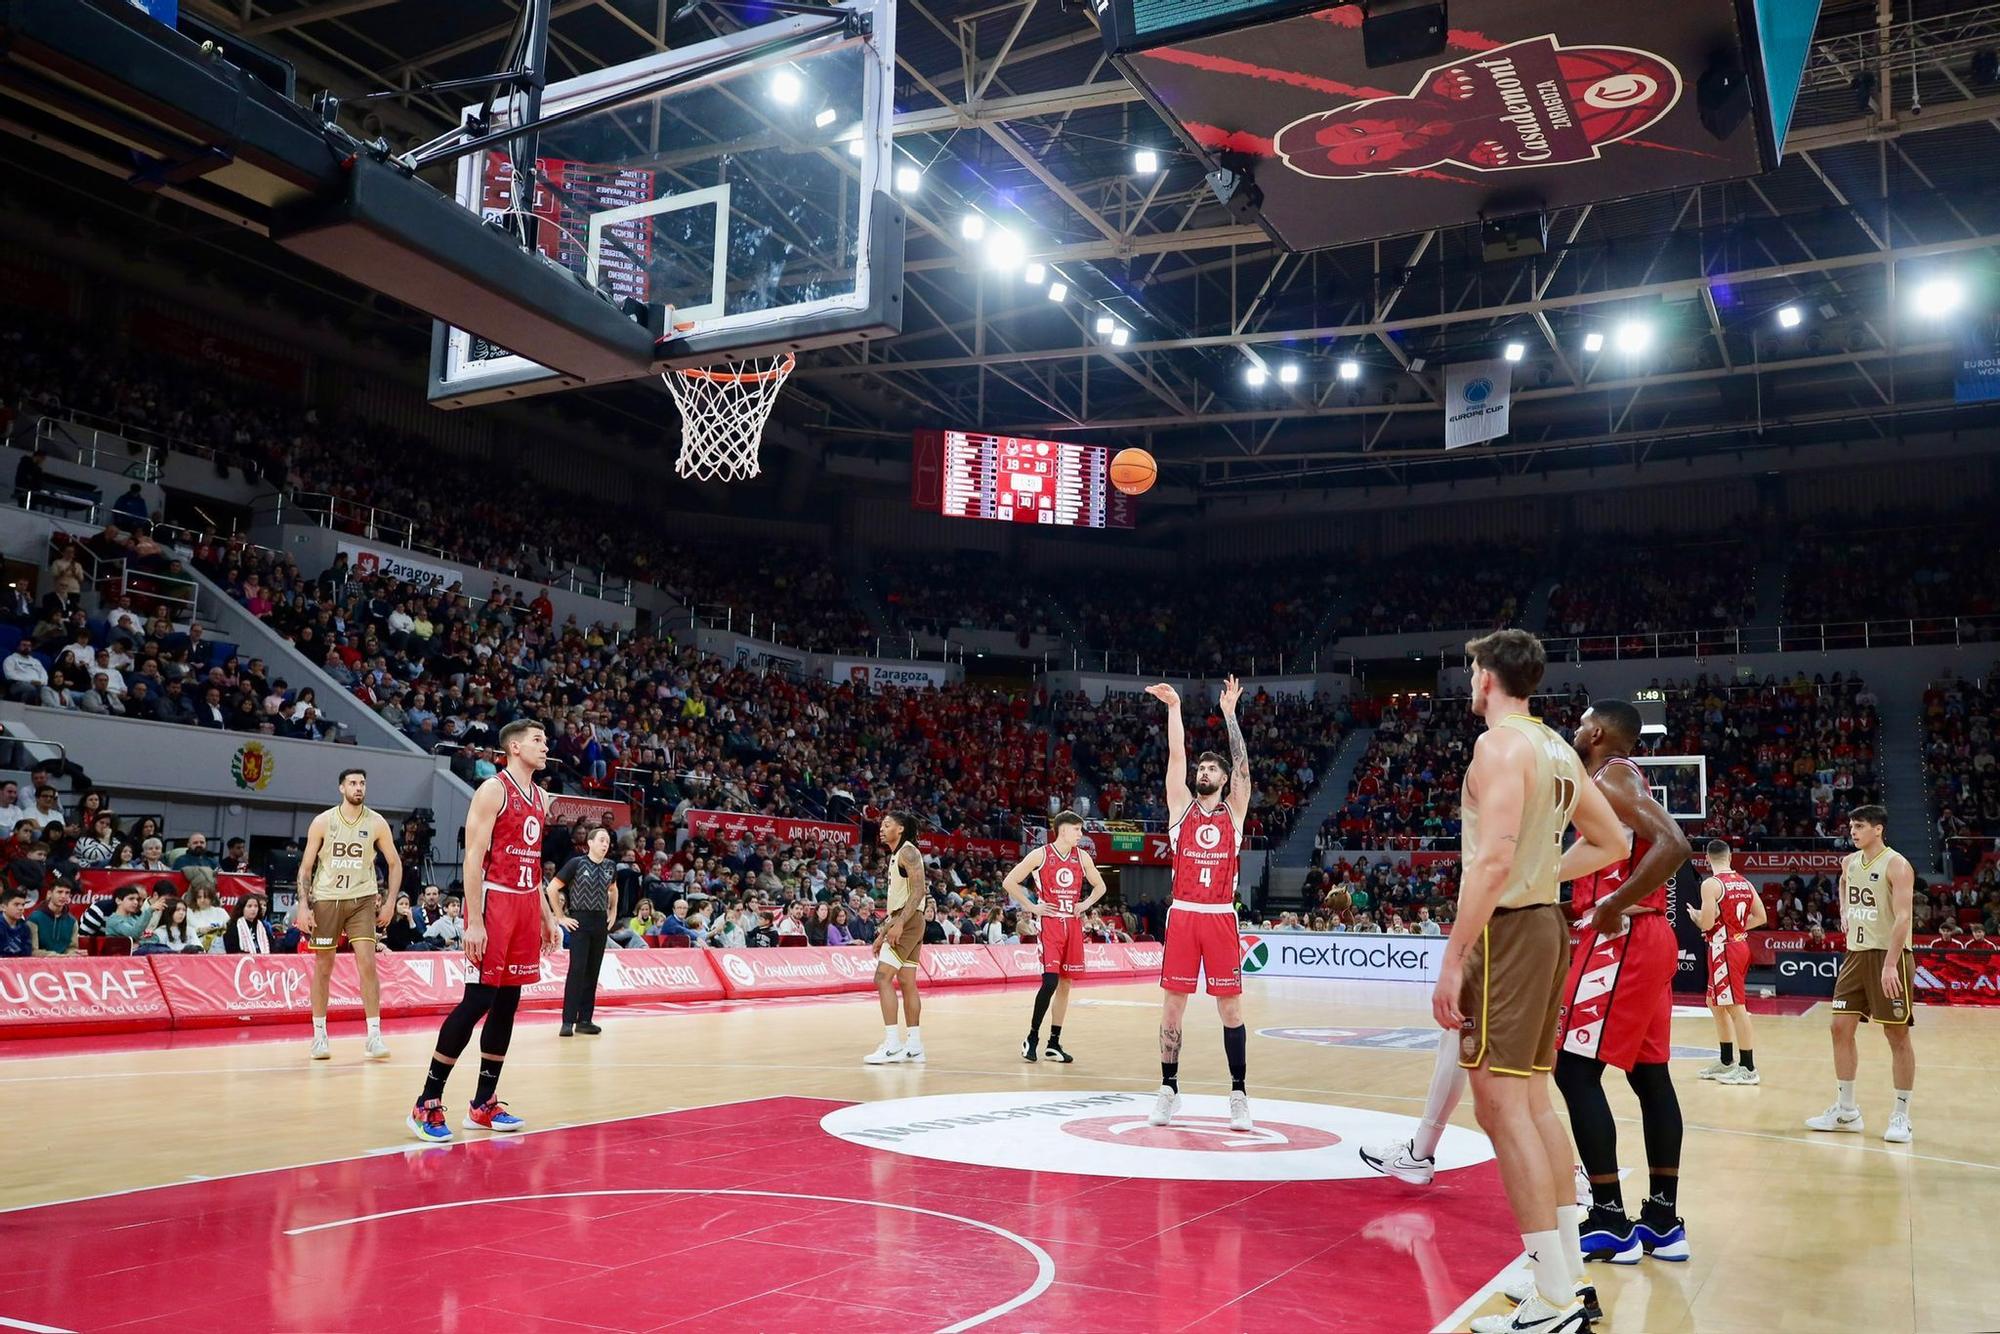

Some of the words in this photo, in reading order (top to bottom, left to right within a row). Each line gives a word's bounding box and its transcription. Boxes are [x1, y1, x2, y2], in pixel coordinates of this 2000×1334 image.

[1474, 57, 1552, 161] Casademont
[1536, 79, 1572, 130] ZARAGOZA
[1449, 409, 1484, 423] EUROPE
[1485, 405, 1504, 415] CUP
[874, 667, 929, 683] Zaragoza
[1636, 690, 1659, 701] 1:49
[788, 826, 803, 839] AIR
[332, 842, 363, 858] BG
[335, 874, 350, 889] 21
[1199, 867, 1212, 888] 4
[1848, 886, 1876, 907] BG
[1058, 899, 1073, 913] 15
[1856, 926, 1864, 944] 6
[752, 960, 829, 978] Casademont
[233, 956, 307, 1011] Corp
